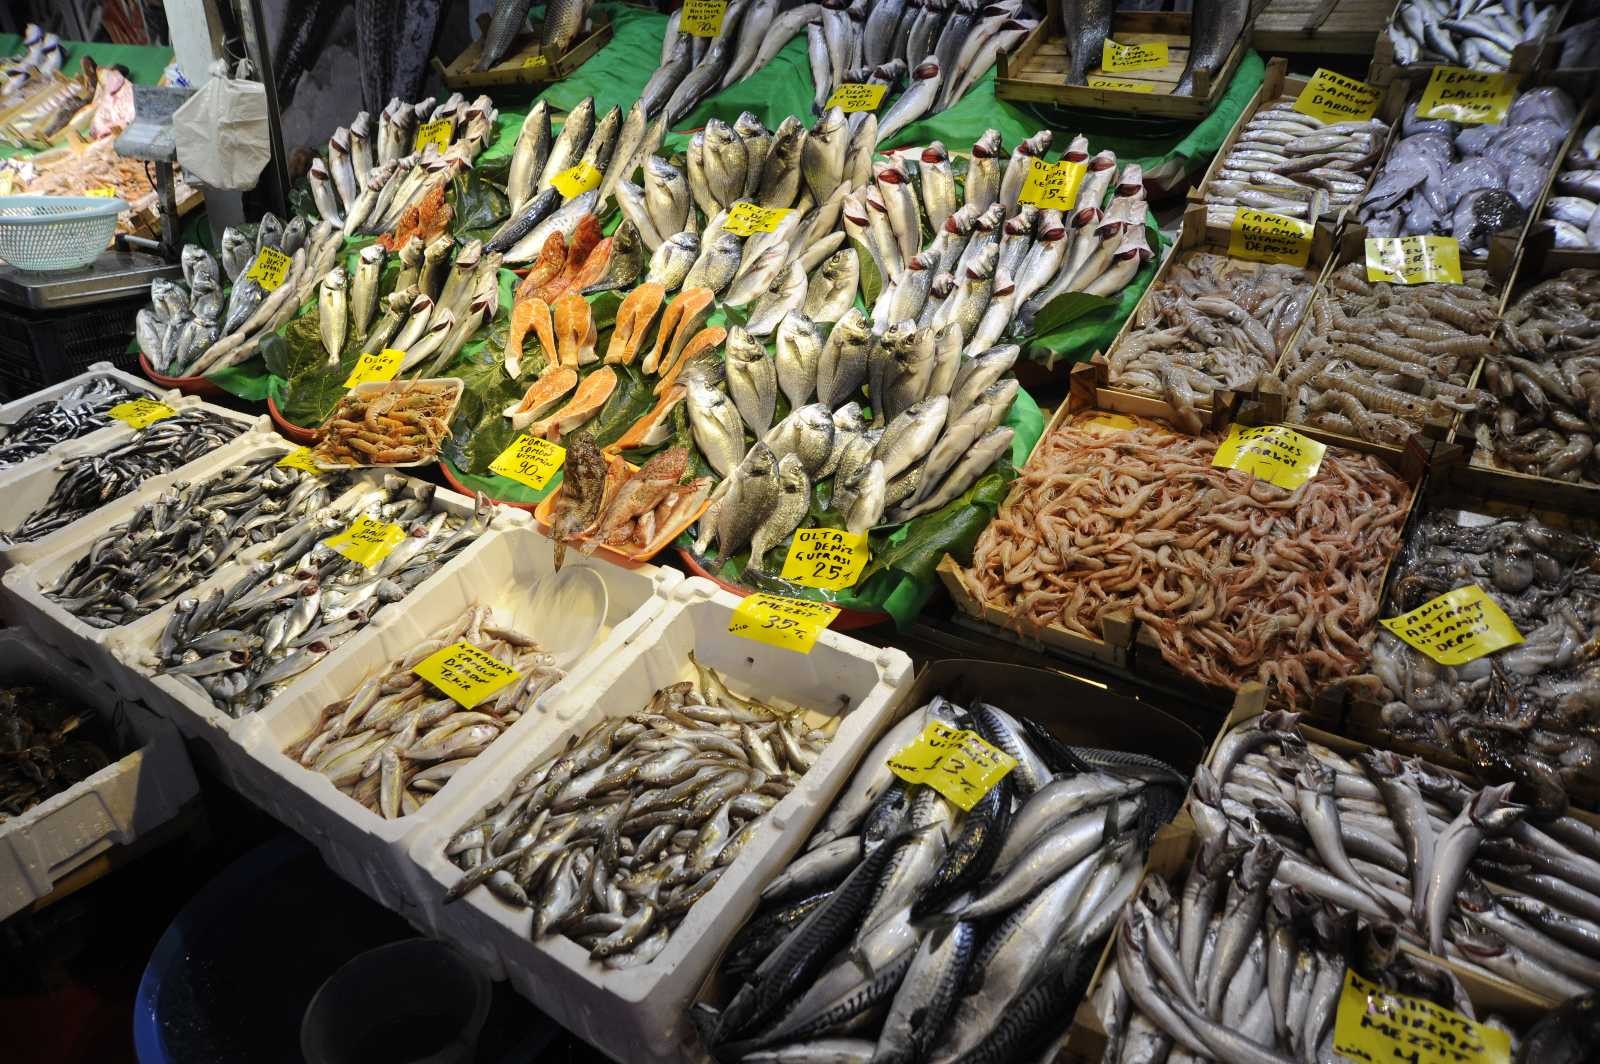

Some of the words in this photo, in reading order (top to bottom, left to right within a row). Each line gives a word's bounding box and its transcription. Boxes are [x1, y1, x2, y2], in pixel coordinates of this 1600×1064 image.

[1241, 211, 1289, 226] CANLI
[1245, 241, 1299, 255] DEPOSU
[799, 532, 843, 543] OLTA
[814, 542, 853, 555] DENİZ
[812, 562, 843, 580] 25
[761, 615, 799, 629] 35
[1389, 600, 1449, 630] CANLI
